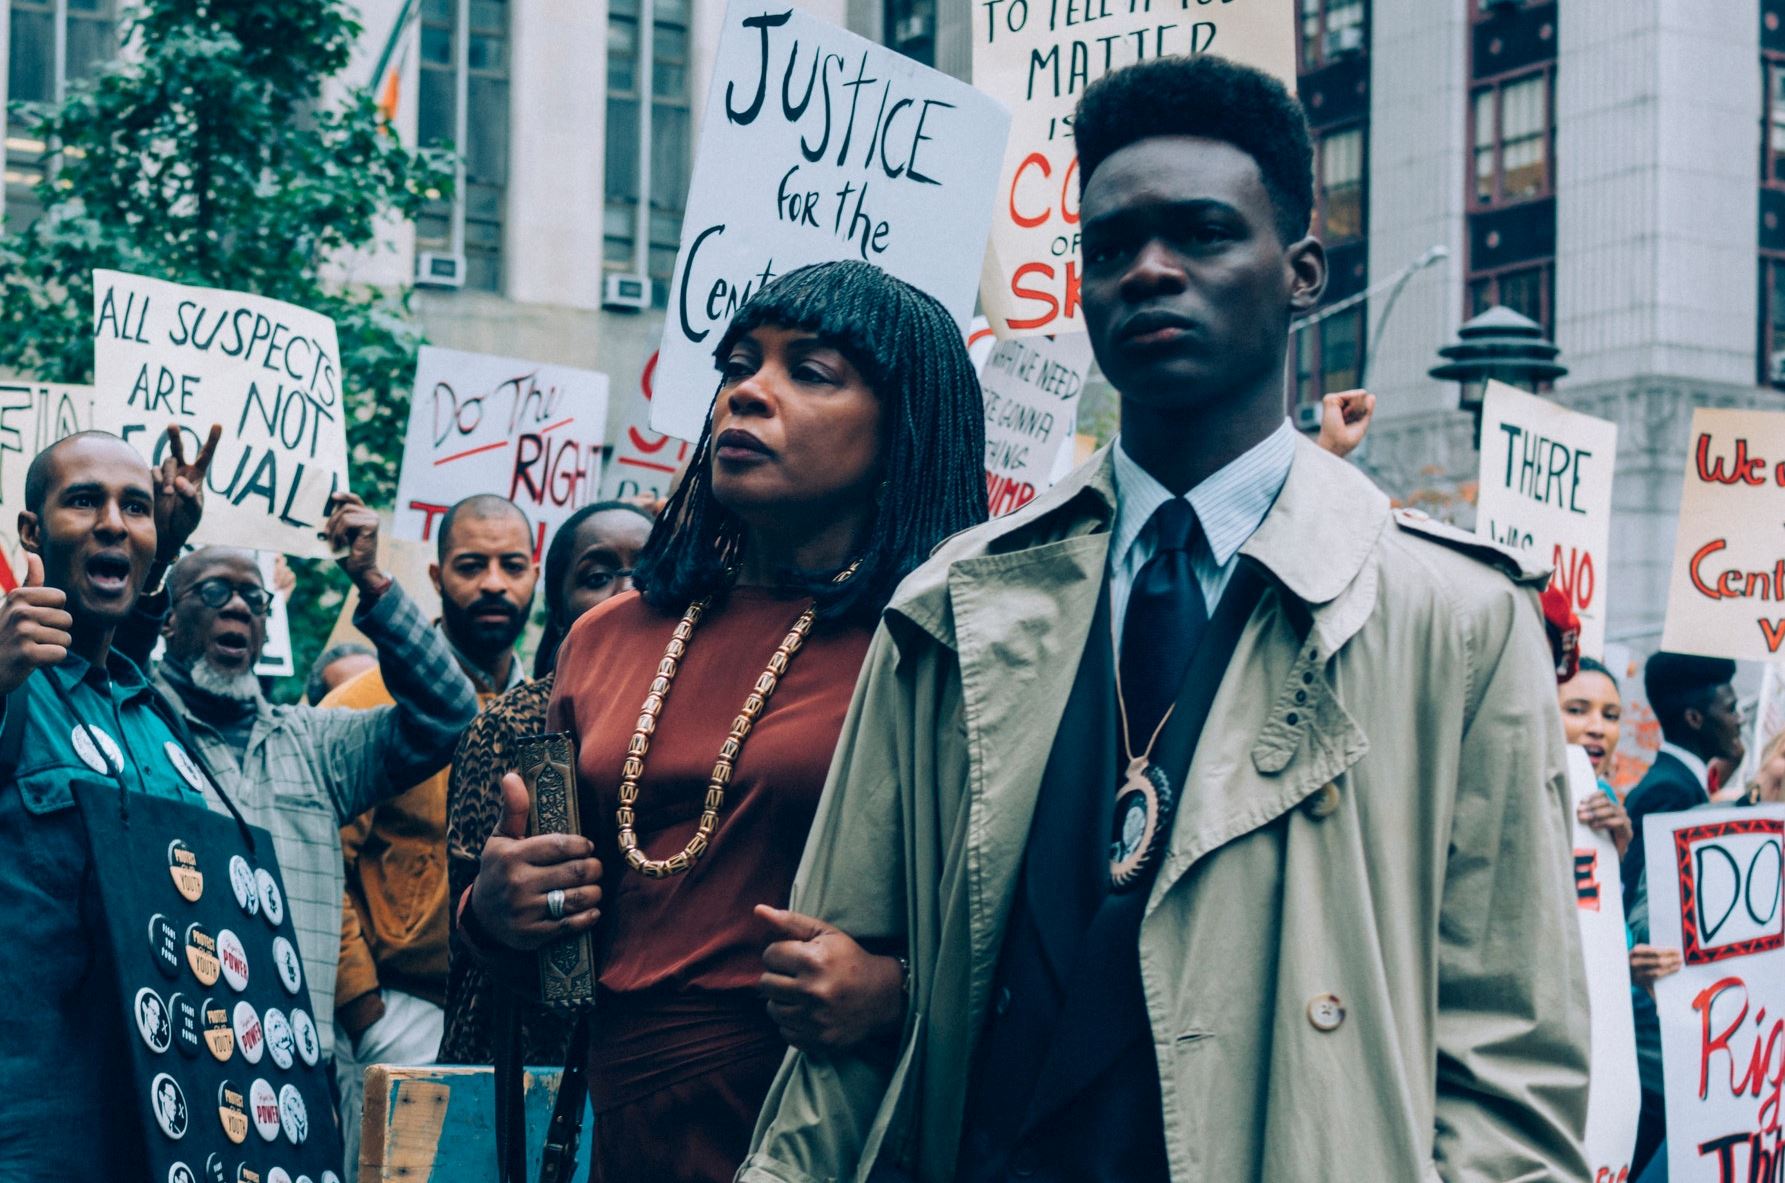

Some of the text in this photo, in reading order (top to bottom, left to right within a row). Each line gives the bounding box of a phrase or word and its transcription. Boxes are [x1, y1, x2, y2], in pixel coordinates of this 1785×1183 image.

[982, 0, 1028, 43] TO
[94, 285, 336, 407] ALL SUSPECTS
[127, 362, 335, 458] ARE NOT
[1500, 422, 1592, 514] THERE
[1552, 543, 1595, 610] NO
[1696, 839, 1783, 943] DO
